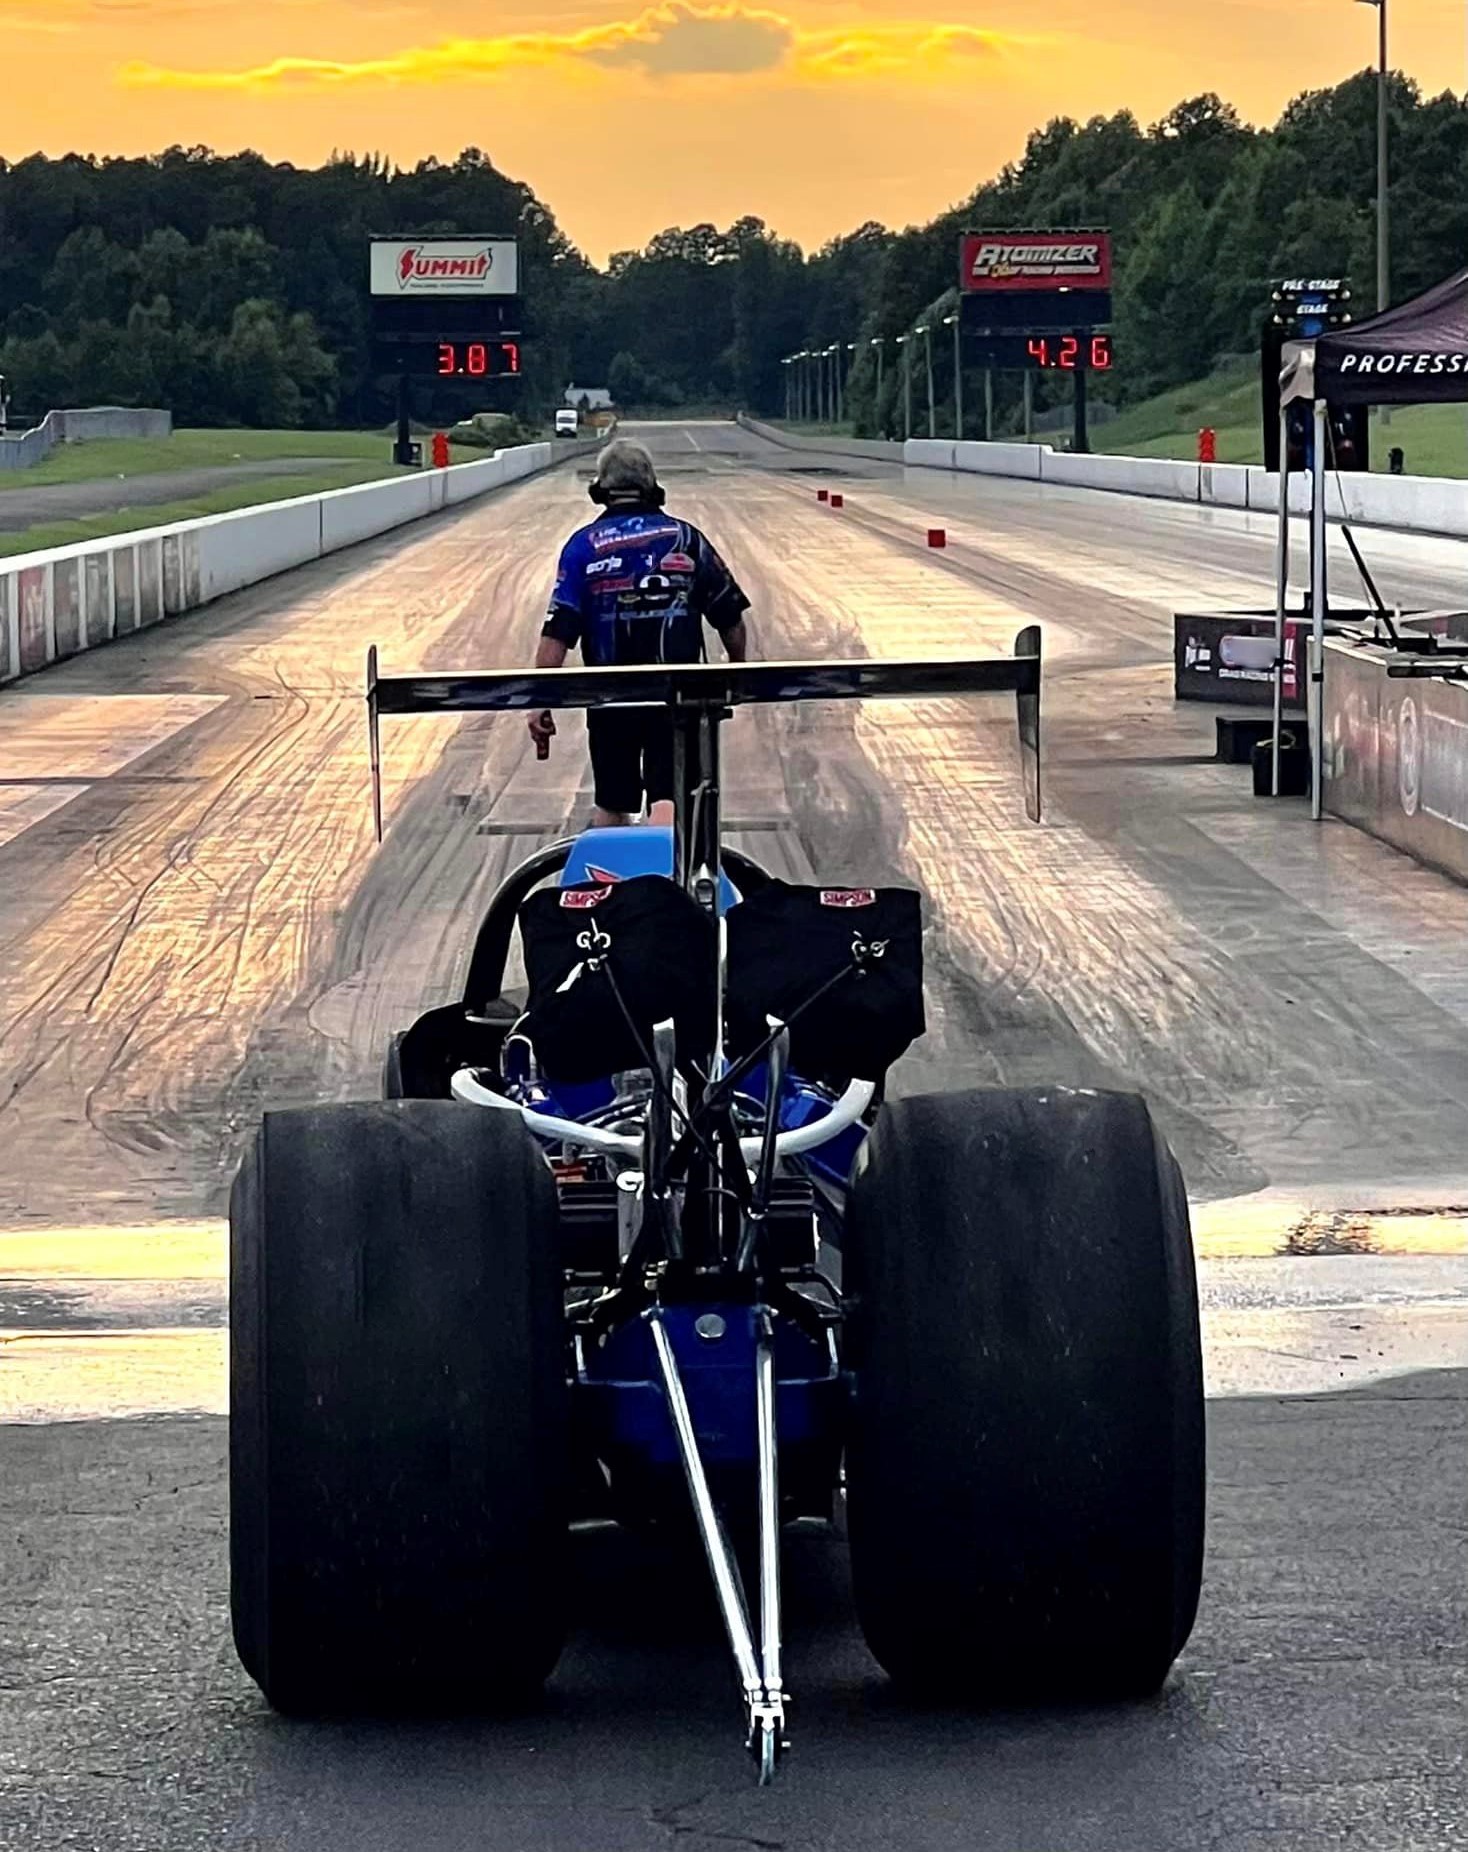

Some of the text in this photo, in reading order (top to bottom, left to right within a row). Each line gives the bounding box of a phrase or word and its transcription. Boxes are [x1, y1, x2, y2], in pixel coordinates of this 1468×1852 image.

[973, 243, 1099, 265] ATOMIZER
[438, 344, 518, 374] 3.07
[1028, 338, 1109, 367] 4.26
[823, 889, 872, 906] SIMPSON
